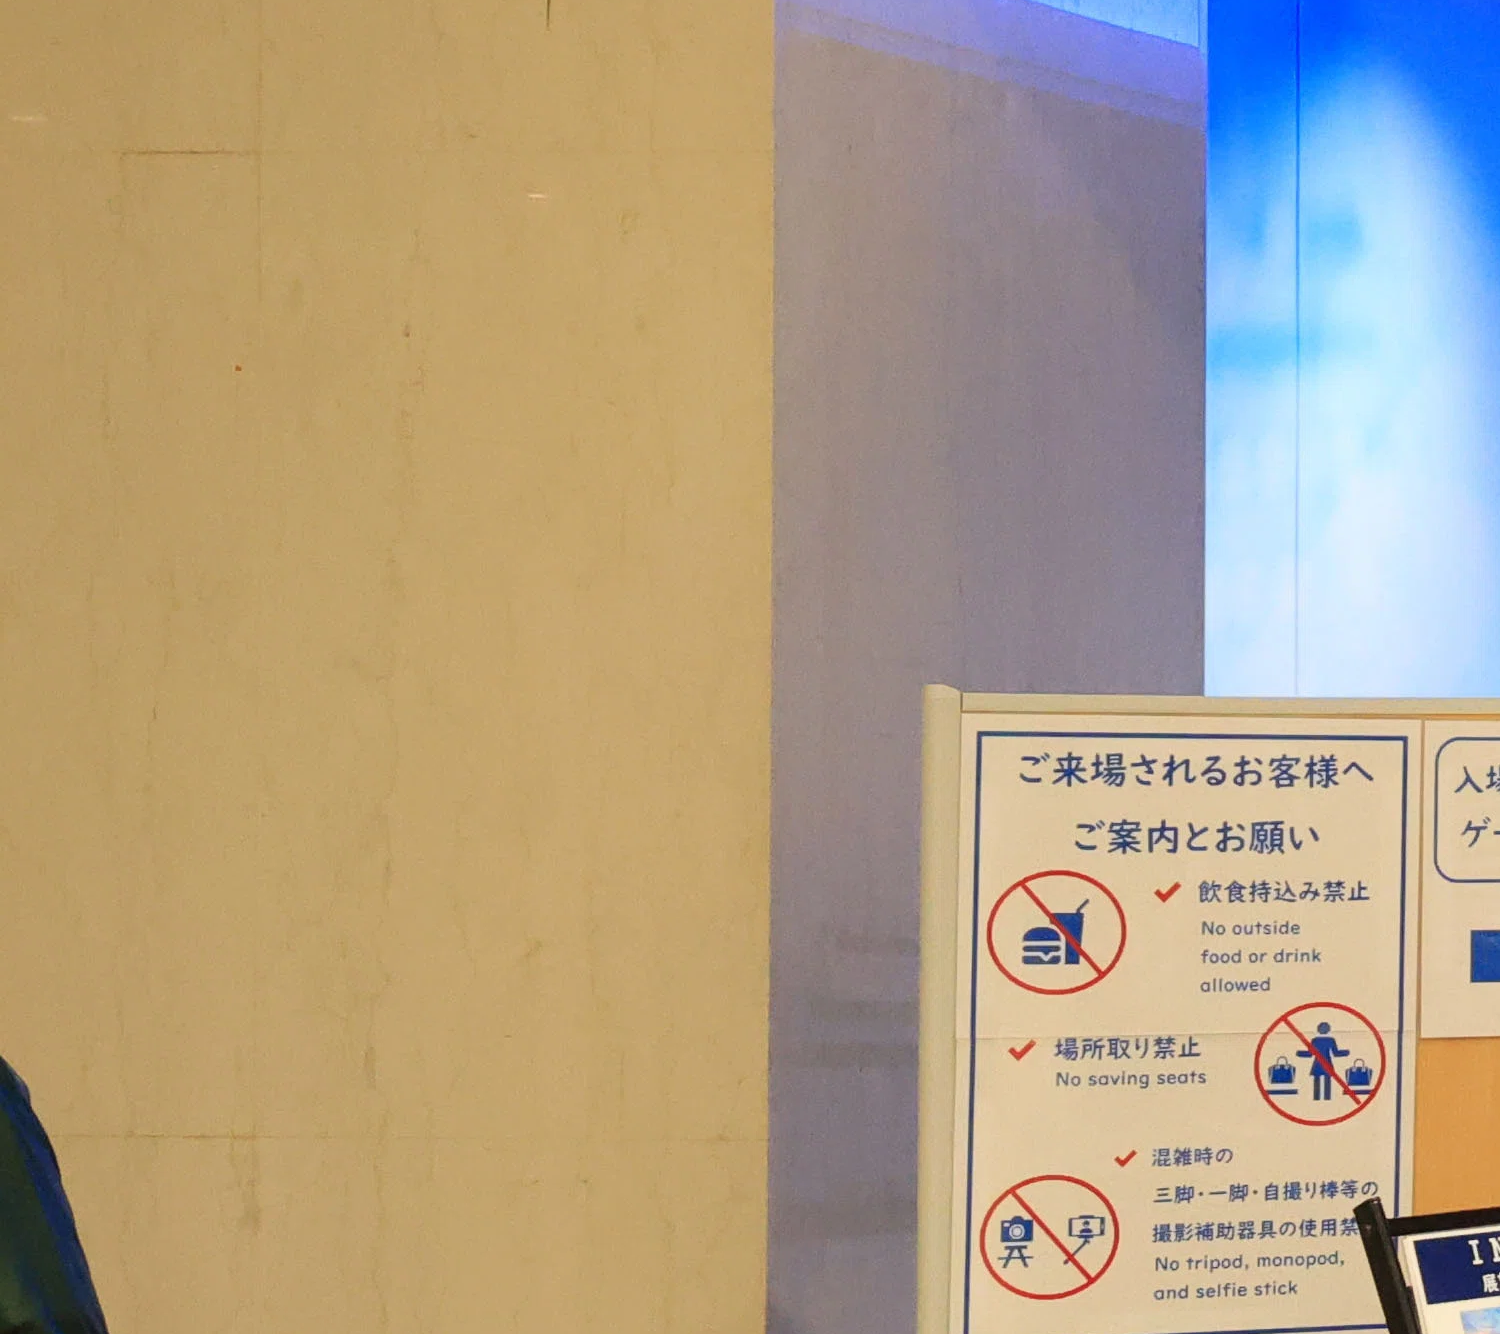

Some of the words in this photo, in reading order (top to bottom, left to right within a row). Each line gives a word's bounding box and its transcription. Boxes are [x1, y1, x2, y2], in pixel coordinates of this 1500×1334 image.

[1018, 752, 1375, 789] ご来場されるお客様へ
[1074, 819, 1321, 855] ご案内とお願い
[1198, 879, 1370, 904] 飲食持込み禁止
[1201, 921, 1226, 936] No
[1231, 920, 1301, 936] outside
[1200, 948, 1242, 964] food
[1248, 952, 1267, 964] or
[1273, 948, 1322, 964] drink
[1200, 977, 1271, 993] allowed
[1053, 1037, 1201, 1061] 場所取り禁止
[1055, 1071, 1082, 1087] No
[1088, 1070, 1150, 1089] saving
[1157, 1070, 1207, 1085] seats
[1151, 1147, 1234, 1168] 混雑時の
[1153, 1179, 1379, 1205] 三脚・一脚・自撮り棒等の
[1155, 1257, 1179, 1272] No
[1186, 1254, 1249, 1274] tripod,
[1257, 1251, 1345, 1273] monopod,
[1154, 1284, 1188, 1300] and
[1196, 1281, 1248, 1299] selfie
[1254, 1281, 1298, 1296] stick
